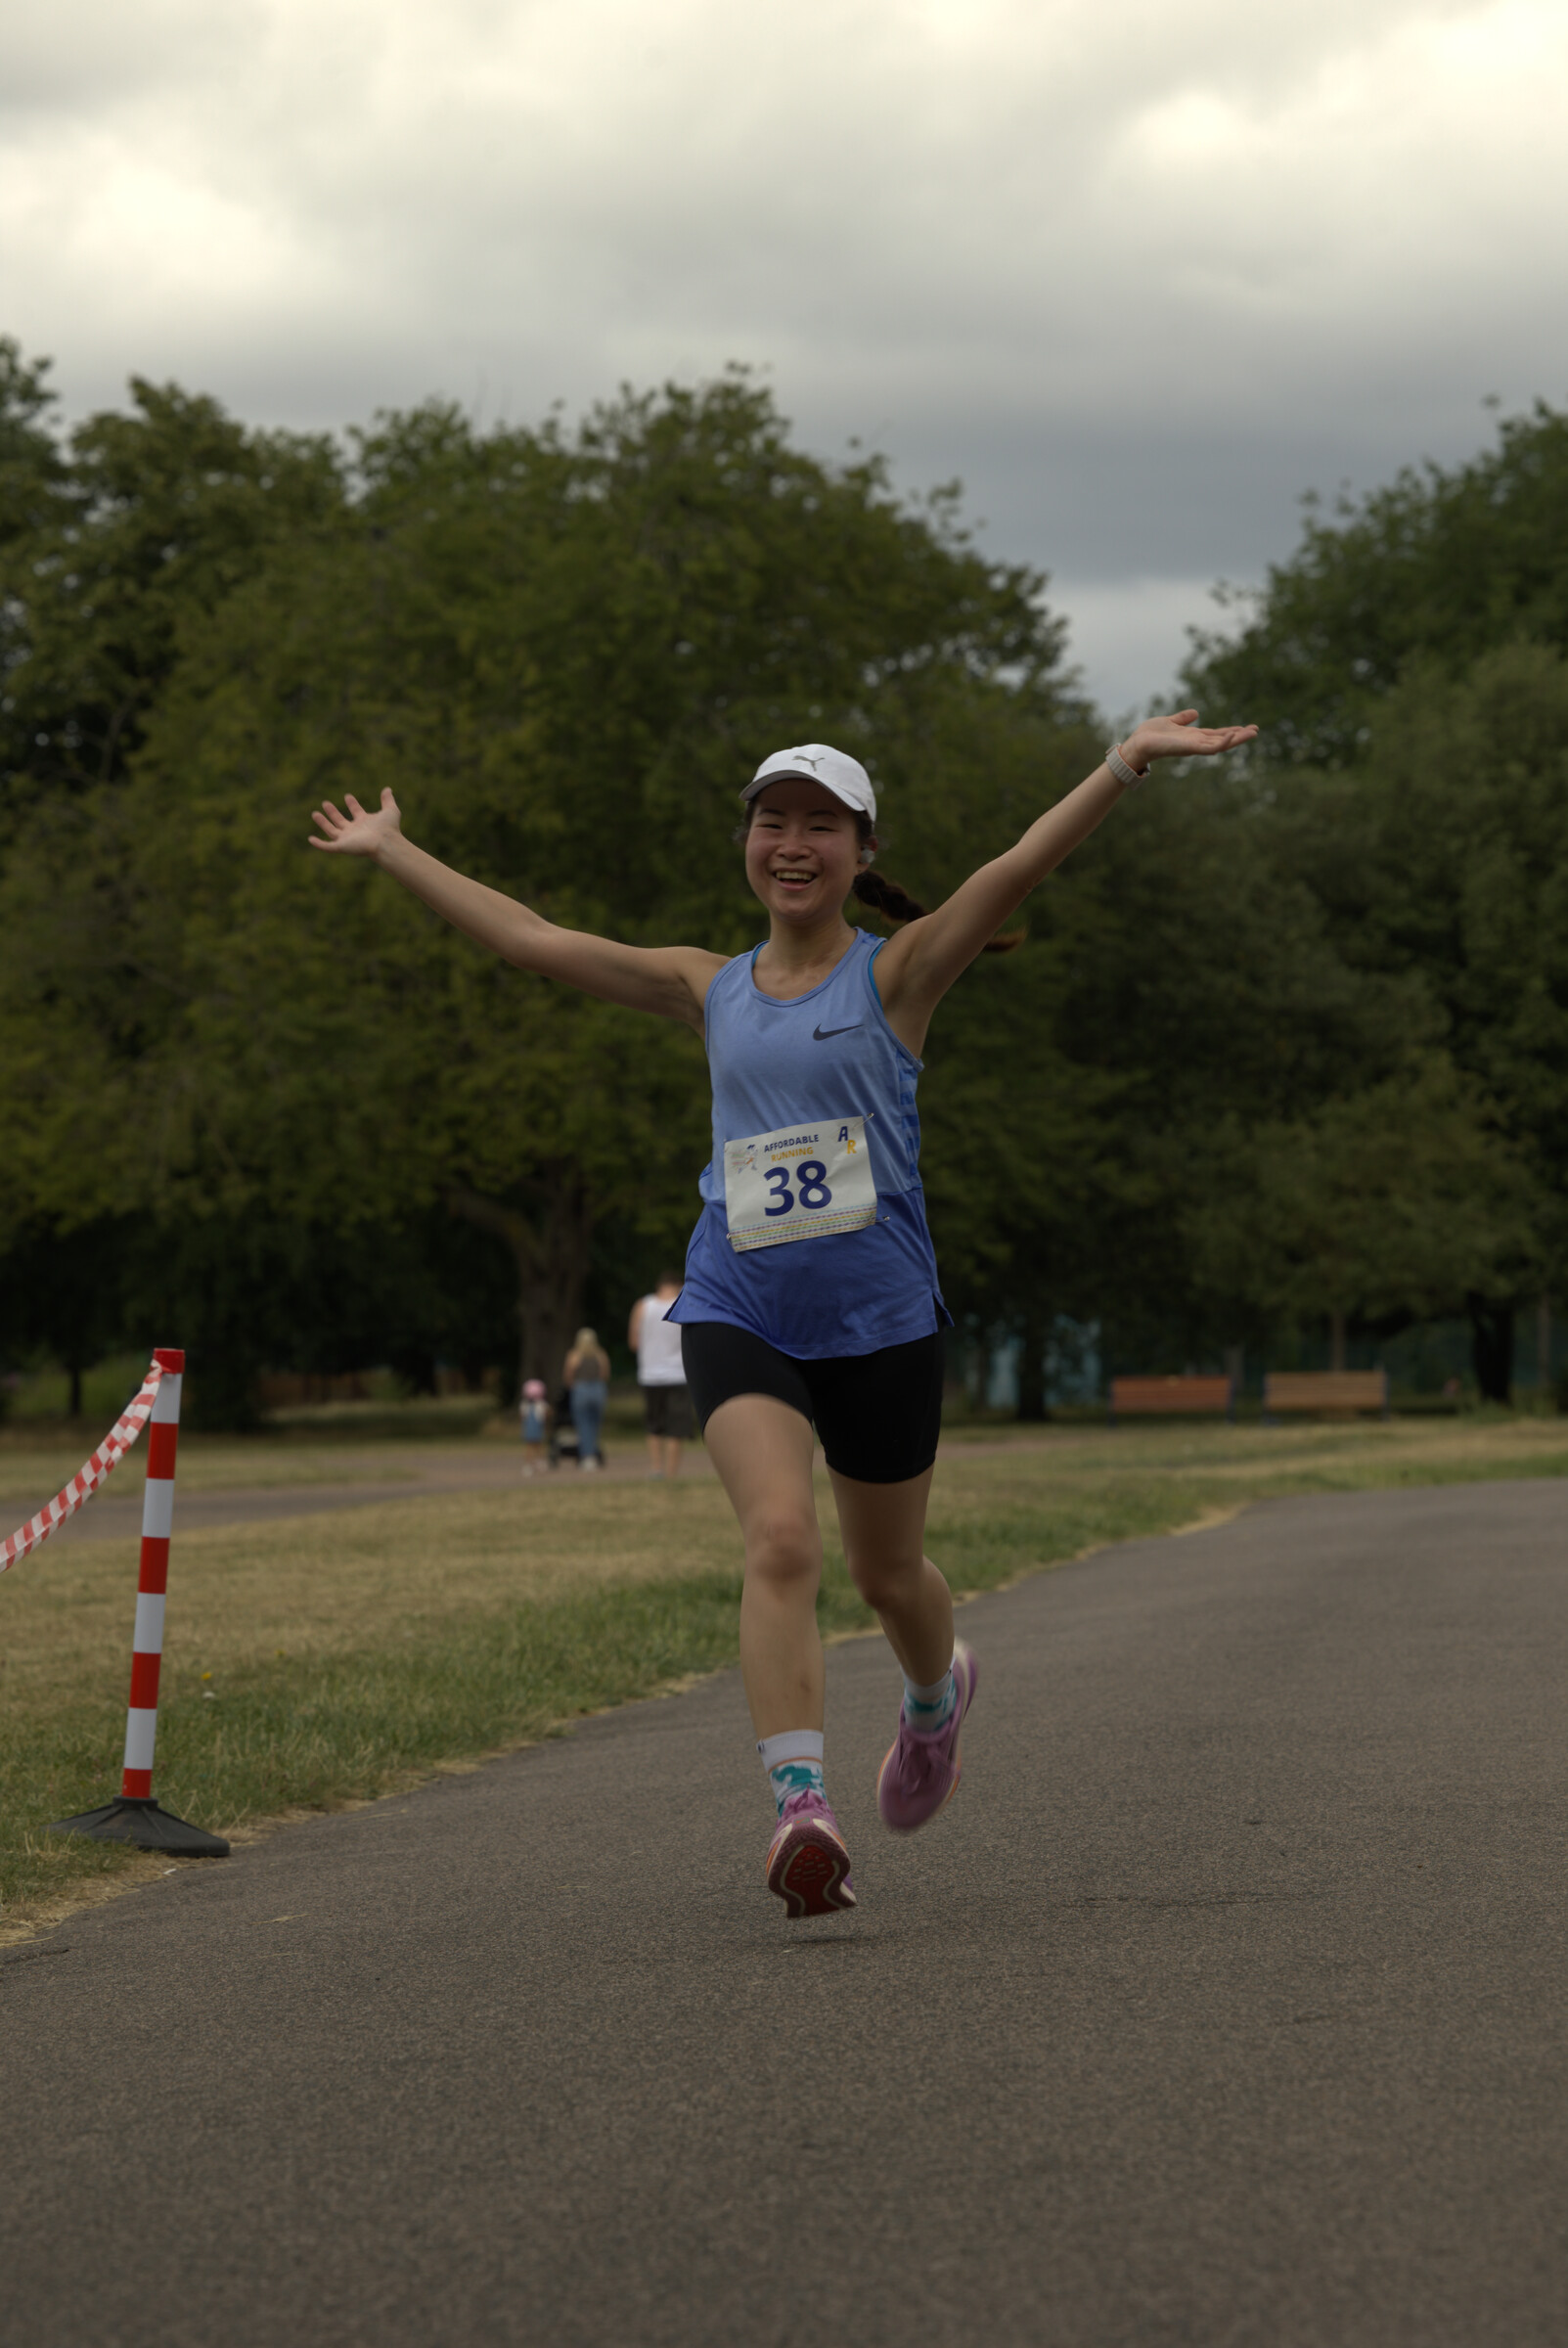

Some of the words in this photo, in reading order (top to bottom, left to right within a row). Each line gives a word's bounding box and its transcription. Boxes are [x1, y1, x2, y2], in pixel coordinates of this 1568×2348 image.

[837, 1126, 848, 1142] A
[764, 1134, 820, 1152] AFFORDABLE
[846, 1139, 857, 1154] R
[771, 1147, 814, 1162] RUNNING
[763, 1160, 832, 1216] 38
